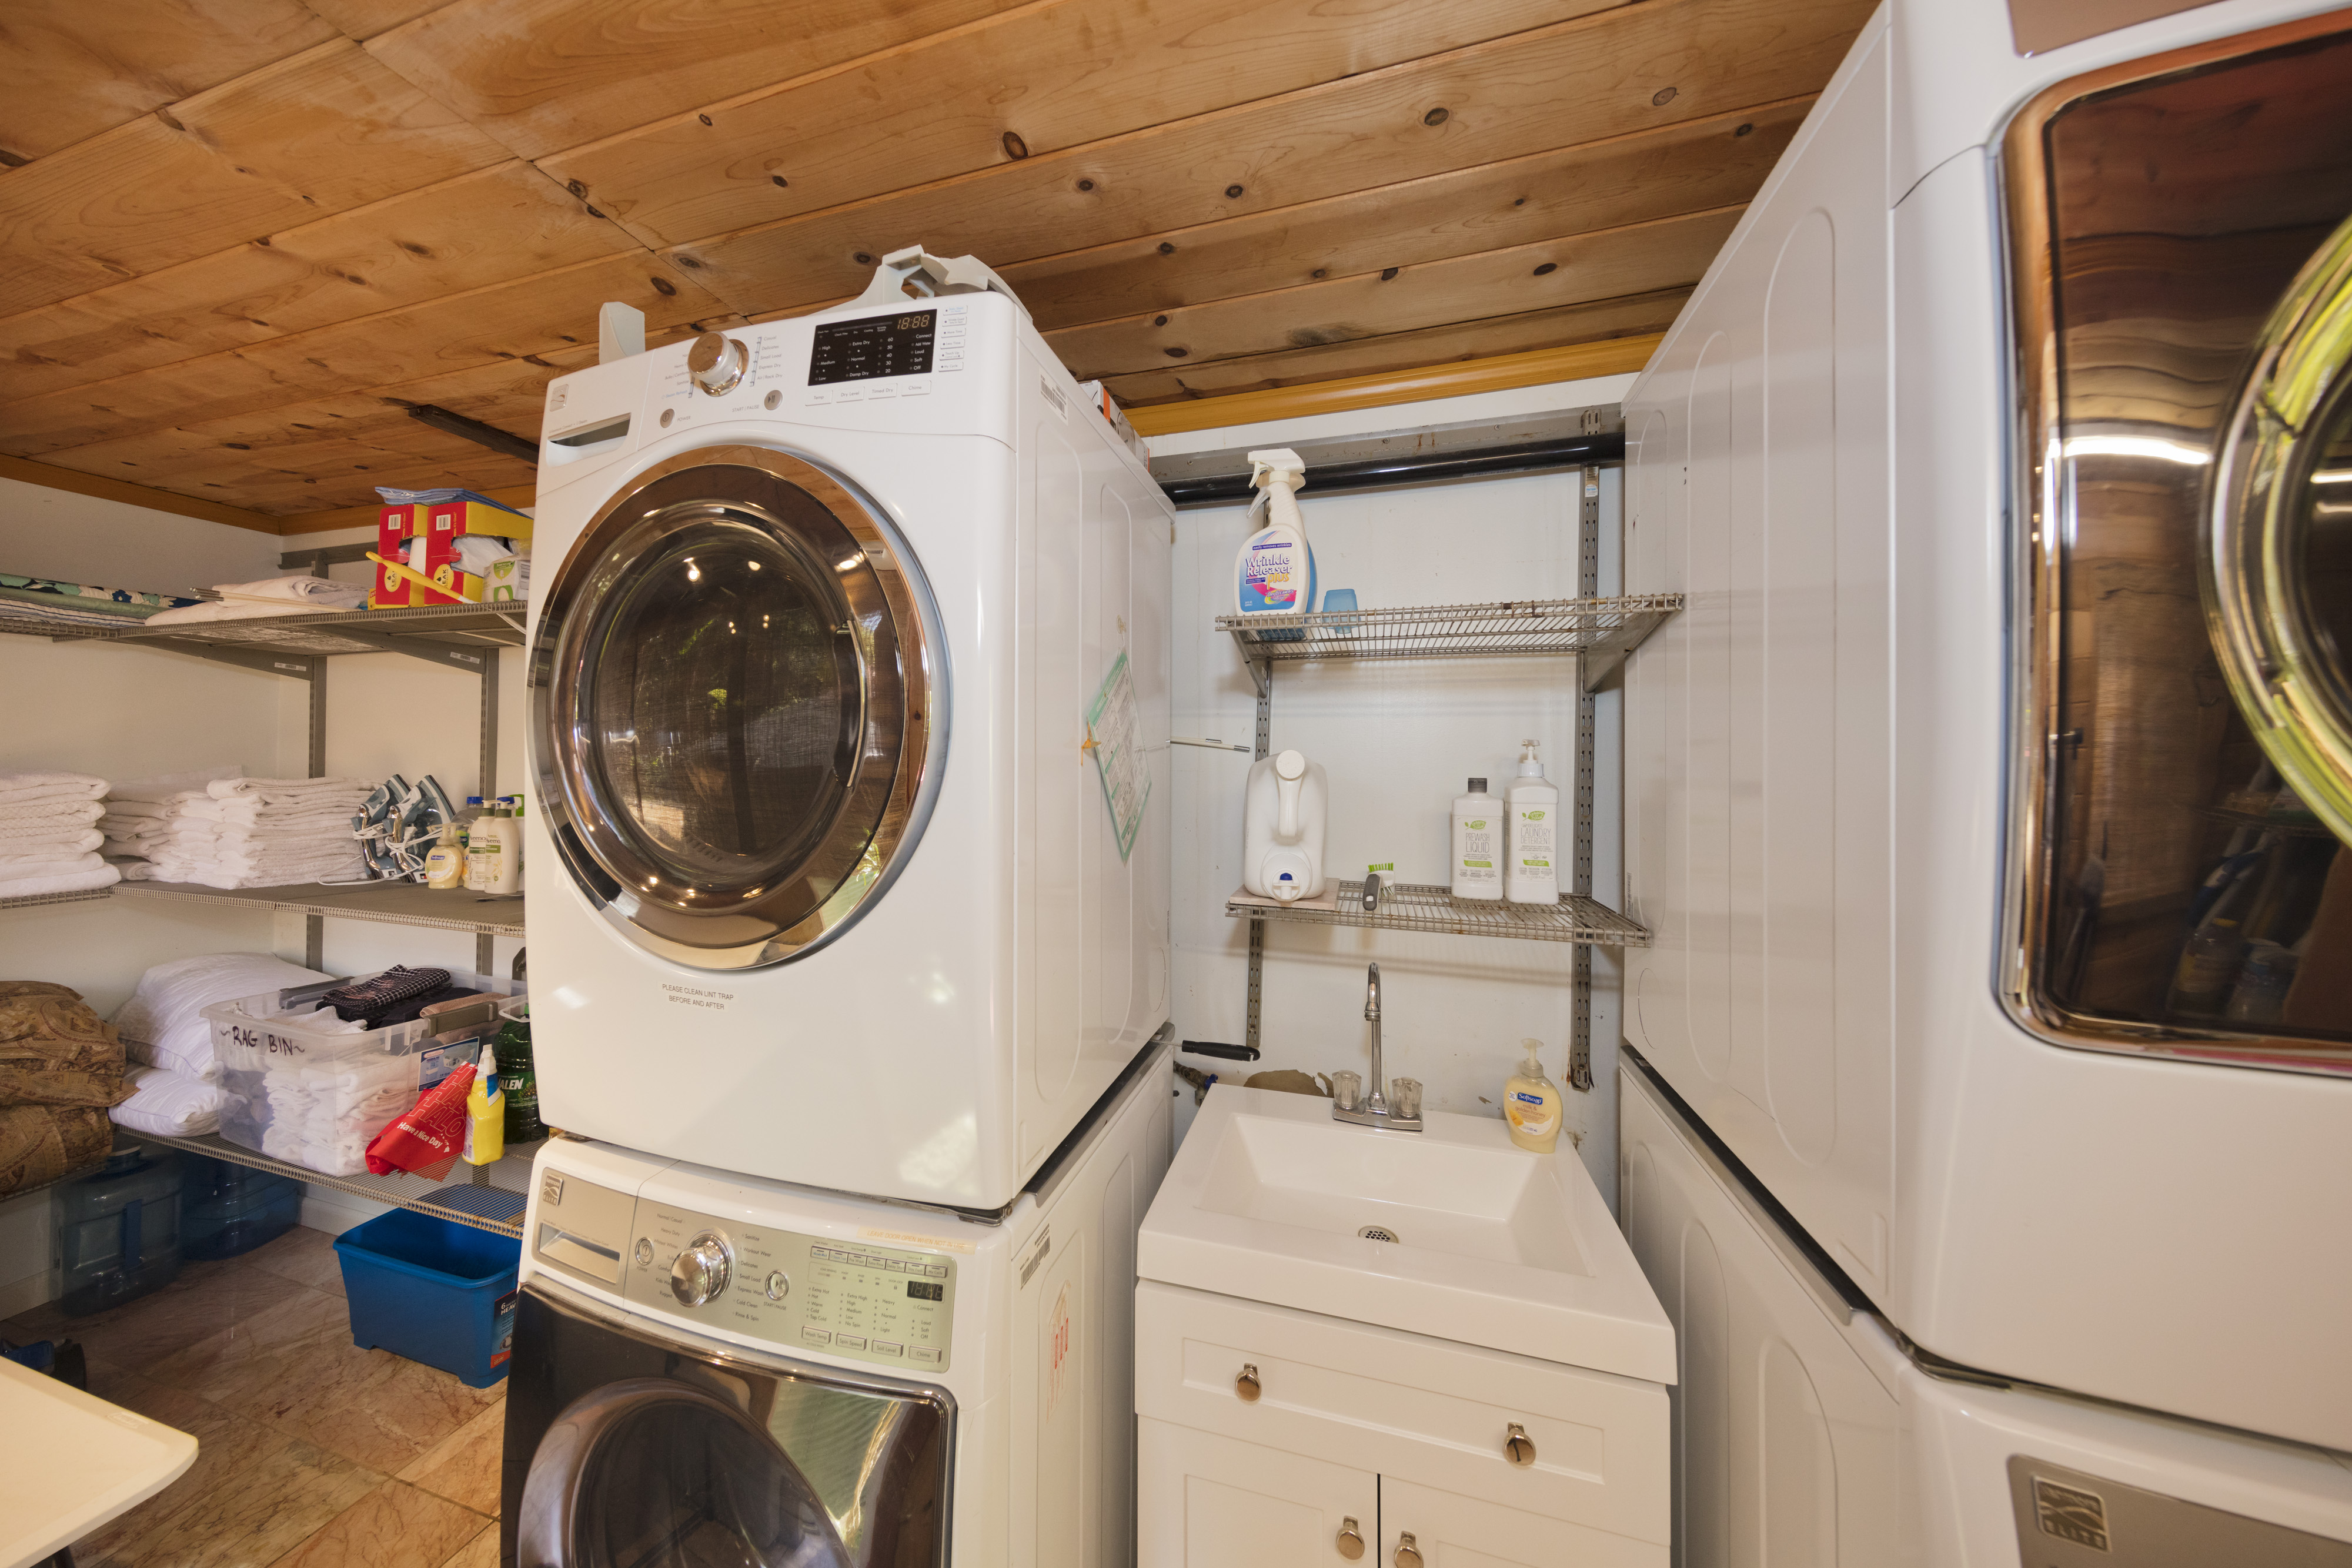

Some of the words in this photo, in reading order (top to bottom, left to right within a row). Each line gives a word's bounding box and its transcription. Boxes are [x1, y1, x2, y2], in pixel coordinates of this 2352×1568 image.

[1246, 554, 1290, 567] Wrinkle
[1247, 565, 1293, 577] Releaser
[1267, 573, 1289, 590] plus
[1466, 833, 1490, 842] PREWASH
[1521, 828, 1551, 837] LAUNDRY
[1521, 837, 1551, 845] DETERGENT
[1466, 841, 1489, 853] LIQUID
[662, 984, 683, 993] PLEASE
[684, 987, 703, 996] CLEAN
[669, 995, 691, 1005] BEFORE
[232, 1025, 258, 1047] RAG
[268, 1034, 293, 1056] BIN
[424, 1081, 467, 1119] HAL
[1519, 1093, 1542, 1104] Softsoap
[407, 1098, 466, 1137] HALO
[1531, 1109, 1546, 1118] honey
[397, 1122, 416, 1134] Have
[417, 1130, 430, 1142] Nice
[429, 1136, 443, 1149] Day
[546, 1178, 560, 1187] Kenmore
[543, 1195, 557, 1204] ELITE
[745, 1233, 760, 1242] Sanitize
[741, 1260, 758, 1269] Delicates
[659, 1290, 673, 1299] Rugged
[501, 1303, 516, 1315] HEAV
